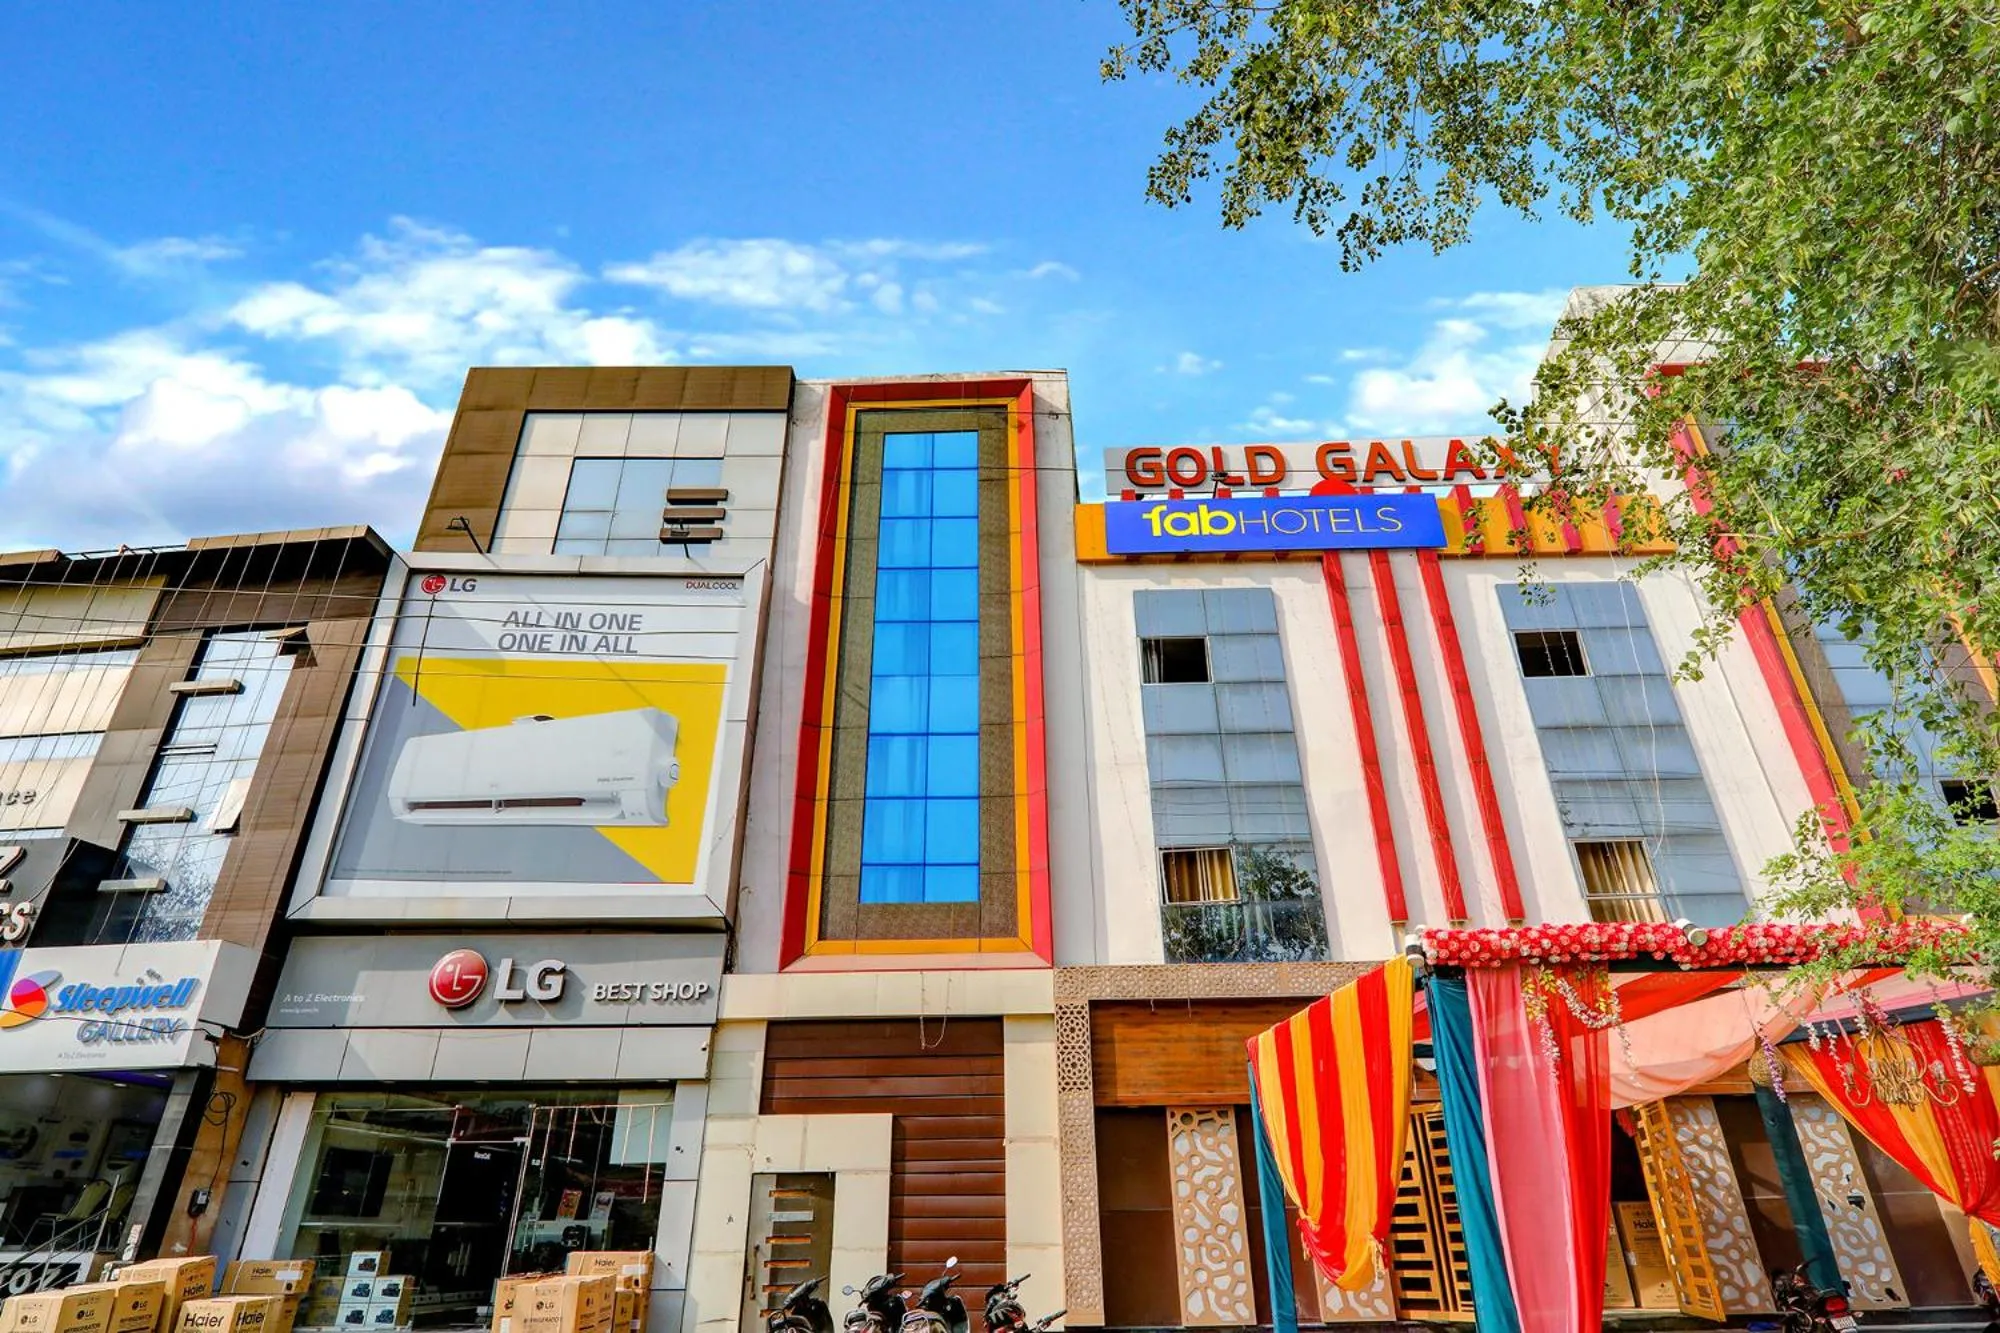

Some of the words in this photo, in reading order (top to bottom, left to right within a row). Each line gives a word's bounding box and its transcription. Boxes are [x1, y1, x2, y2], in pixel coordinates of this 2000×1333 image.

[1125, 446, 1287, 487] GOLD
[449, 578, 477, 592] LG
[502, 611, 542, 628] ALL
[555, 612, 582, 629] IN
[589, 613, 643, 631] ONE
[498, 633, 553, 650] ONE
[560, 634, 587, 651] IN
[594, 635, 638, 653] ALL
[0, 789, 36, 806] ce
[493, 958, 567, 1001] LG
[593, 982, 648, 1001] BEST
[650, 982, 709, 1001] SHOP
[77, 1018, 184, 1043] GALLERY
[183, 1283, 207, 1297] Haier
[183, 1312, 225, 1327] Haier
